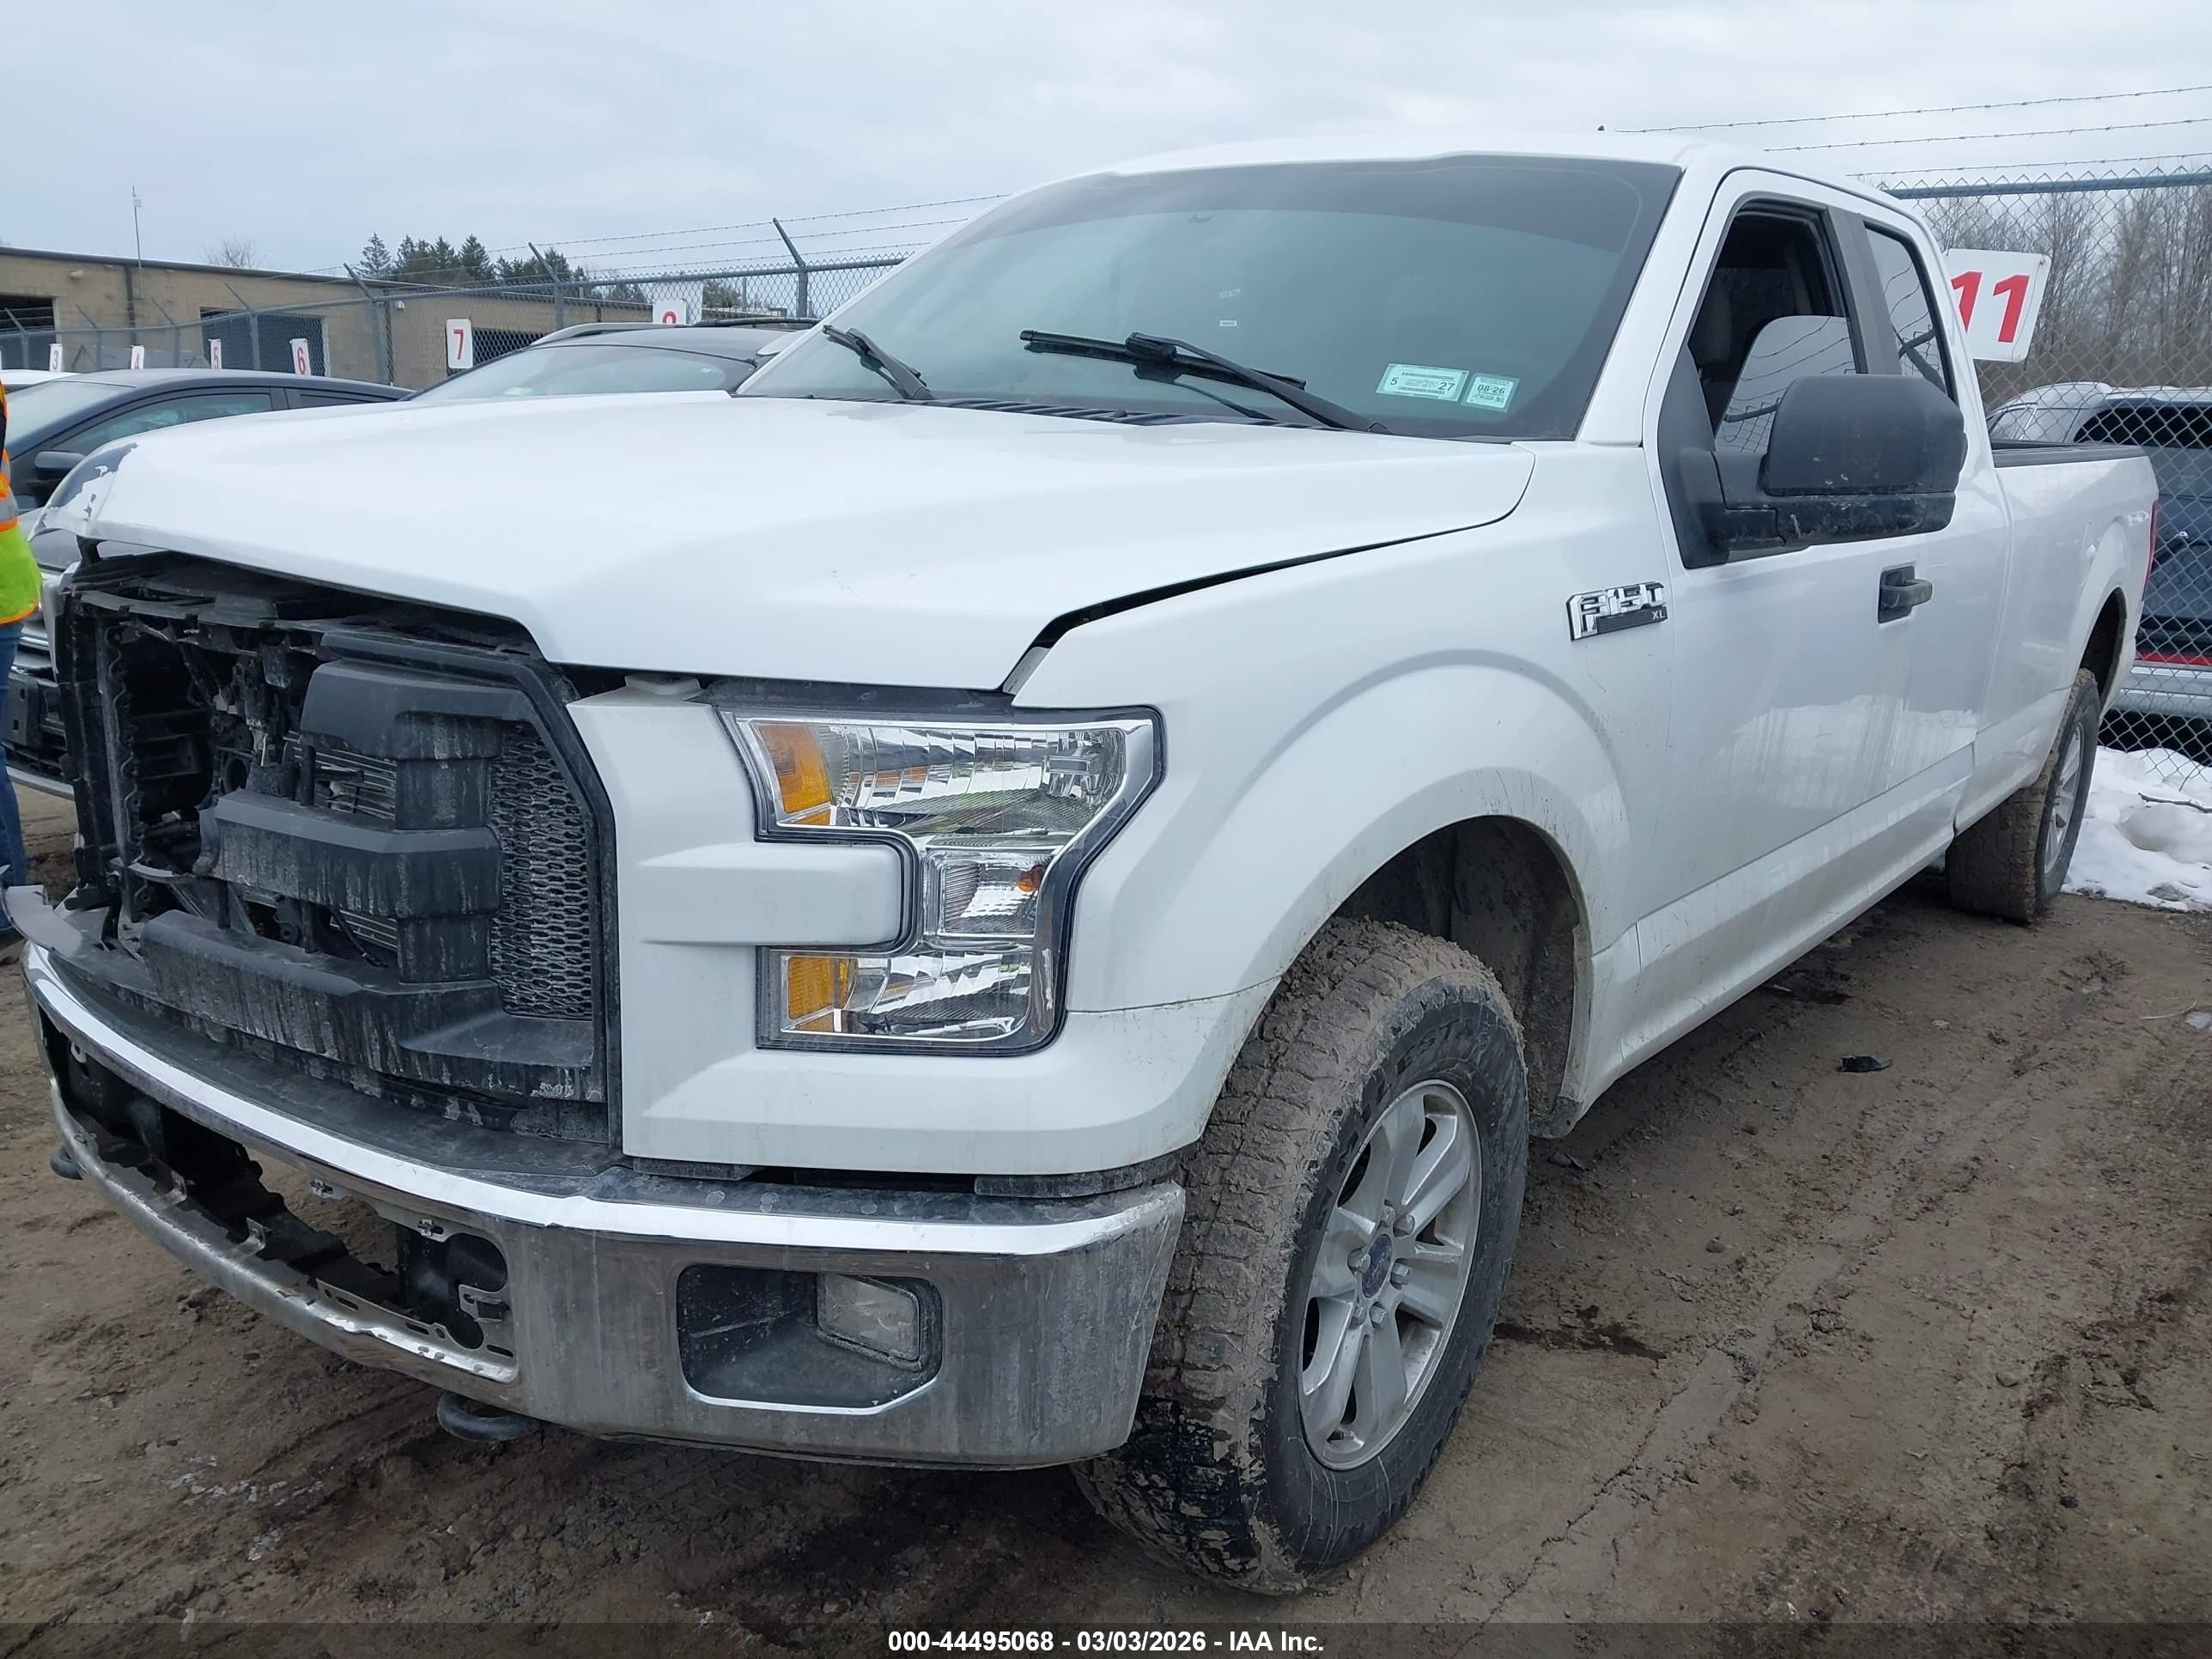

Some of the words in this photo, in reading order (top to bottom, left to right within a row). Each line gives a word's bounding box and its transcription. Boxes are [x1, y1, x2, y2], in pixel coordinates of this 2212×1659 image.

[1950, 270, 2030, 343] 11
[453, 328, 464, 360] 7
[52, 349, 58, 370] 3
[297, 346, 306, 375] 6
[1437, 381, 1455, 392] 27
[1652, 610, 1666, 620] XL
